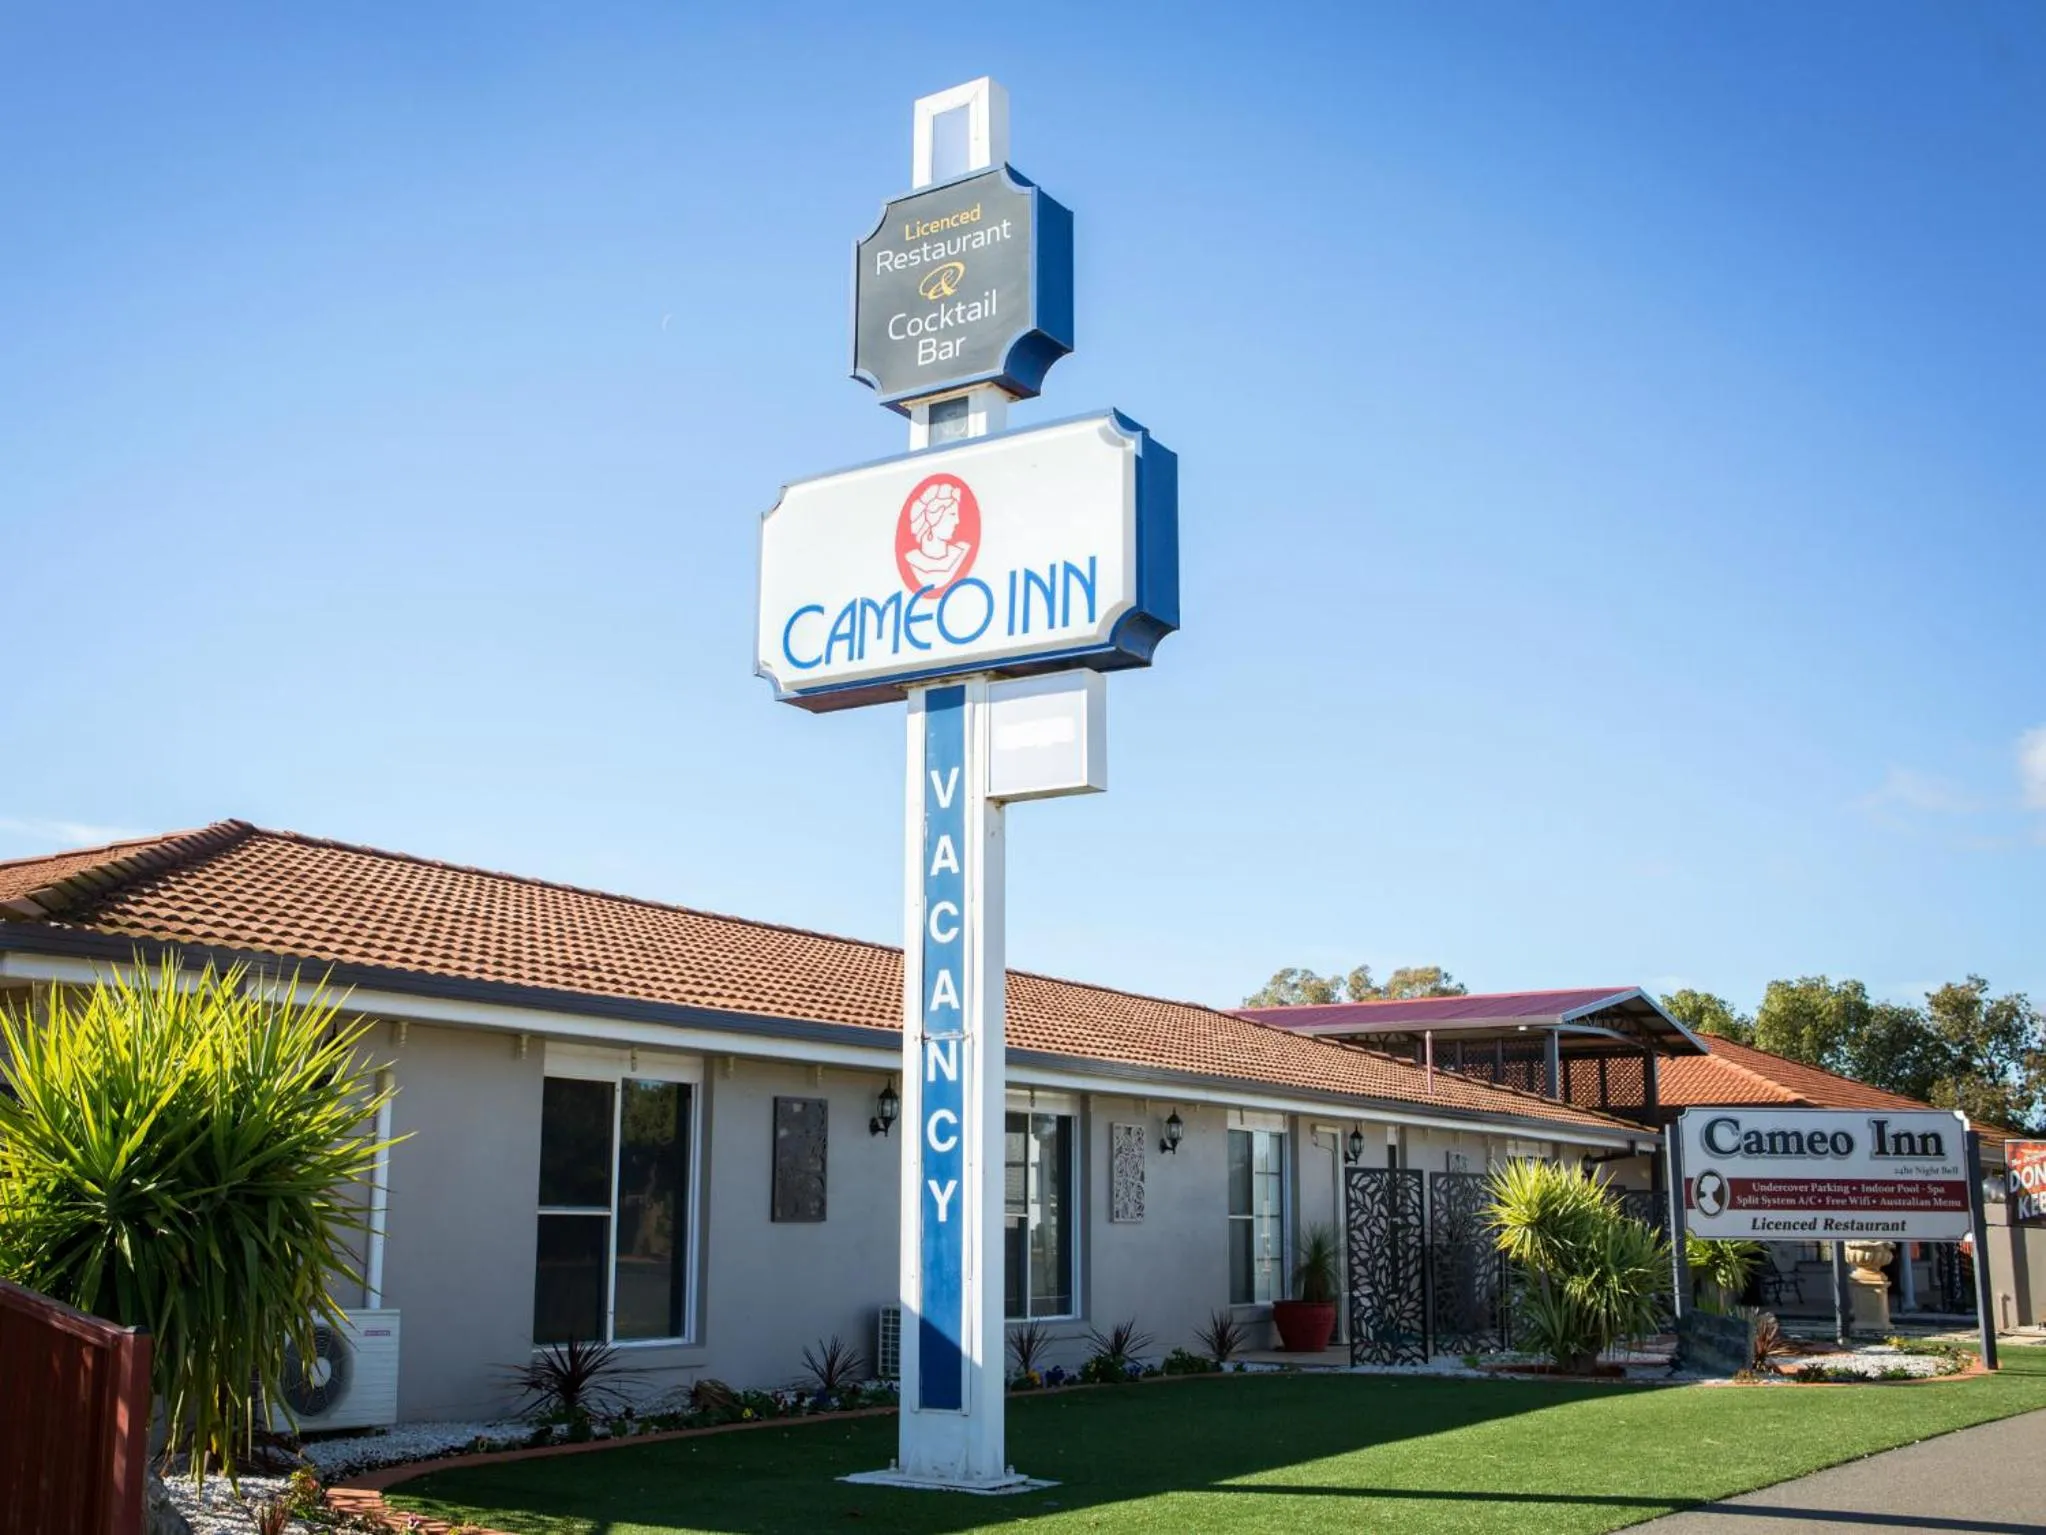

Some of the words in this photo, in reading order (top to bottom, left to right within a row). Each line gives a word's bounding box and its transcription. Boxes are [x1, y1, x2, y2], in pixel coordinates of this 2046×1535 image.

[904, 203, 982, 241] Licenced
[876, 219, 1013, 275] Restaurant
[888, 289, 998, 341] Cocktail
[918, 336, 967, 366] Bar
[782, 577, 995, 670] CAMEO
[1007, 556, 1097, 637] INN
[926, 767, 961, 1223] VACANCY
[1702, 1117, 1855, 1157] Cameo
[1870, 1118, 1947, 1158] Inn
[1752, 1182, 1808, 1192] Undercover
[1810, 1183, 1850, 1194] Parking
[1861, 1184, 1895, 1193] Indoor
[1897, 1184, 1920, 1194] Pool
[1927, 1184, 1945, 1196] Spa
[1915, 1165, 1939, 1177] Night
[1736, 1195, 1760, 1207] Split
[1761, 1196, 1796, 1207] System
[1825, 1196, 1846, 1206] Free
[1880, 1197, 1931, 1206] Australian
[1933, 1198, 1962, 1207] Menu
[1750, 1217, 1818, 1231] Licenced
[1823, 1218, 1907, 1232] Restaurant
